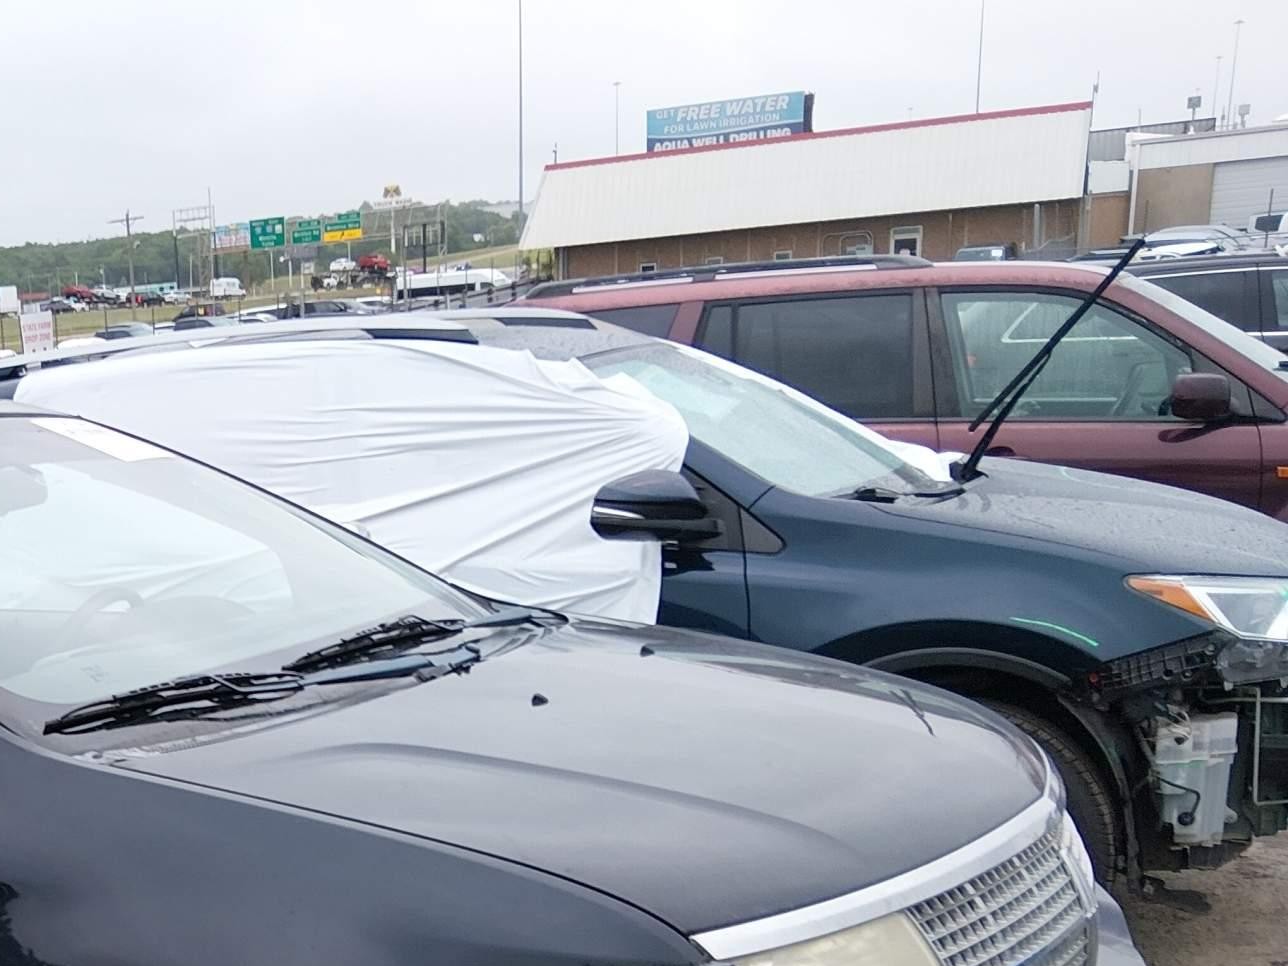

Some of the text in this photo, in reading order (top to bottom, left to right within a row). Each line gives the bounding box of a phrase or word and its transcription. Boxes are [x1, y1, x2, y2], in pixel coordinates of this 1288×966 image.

[656, 95, 790, 122] GET FREE WATER
[664, 113, 780, 134] FOR LAWN IRRIGATION
[654, 127, 792, 152] AQUA WELL DRILLING
